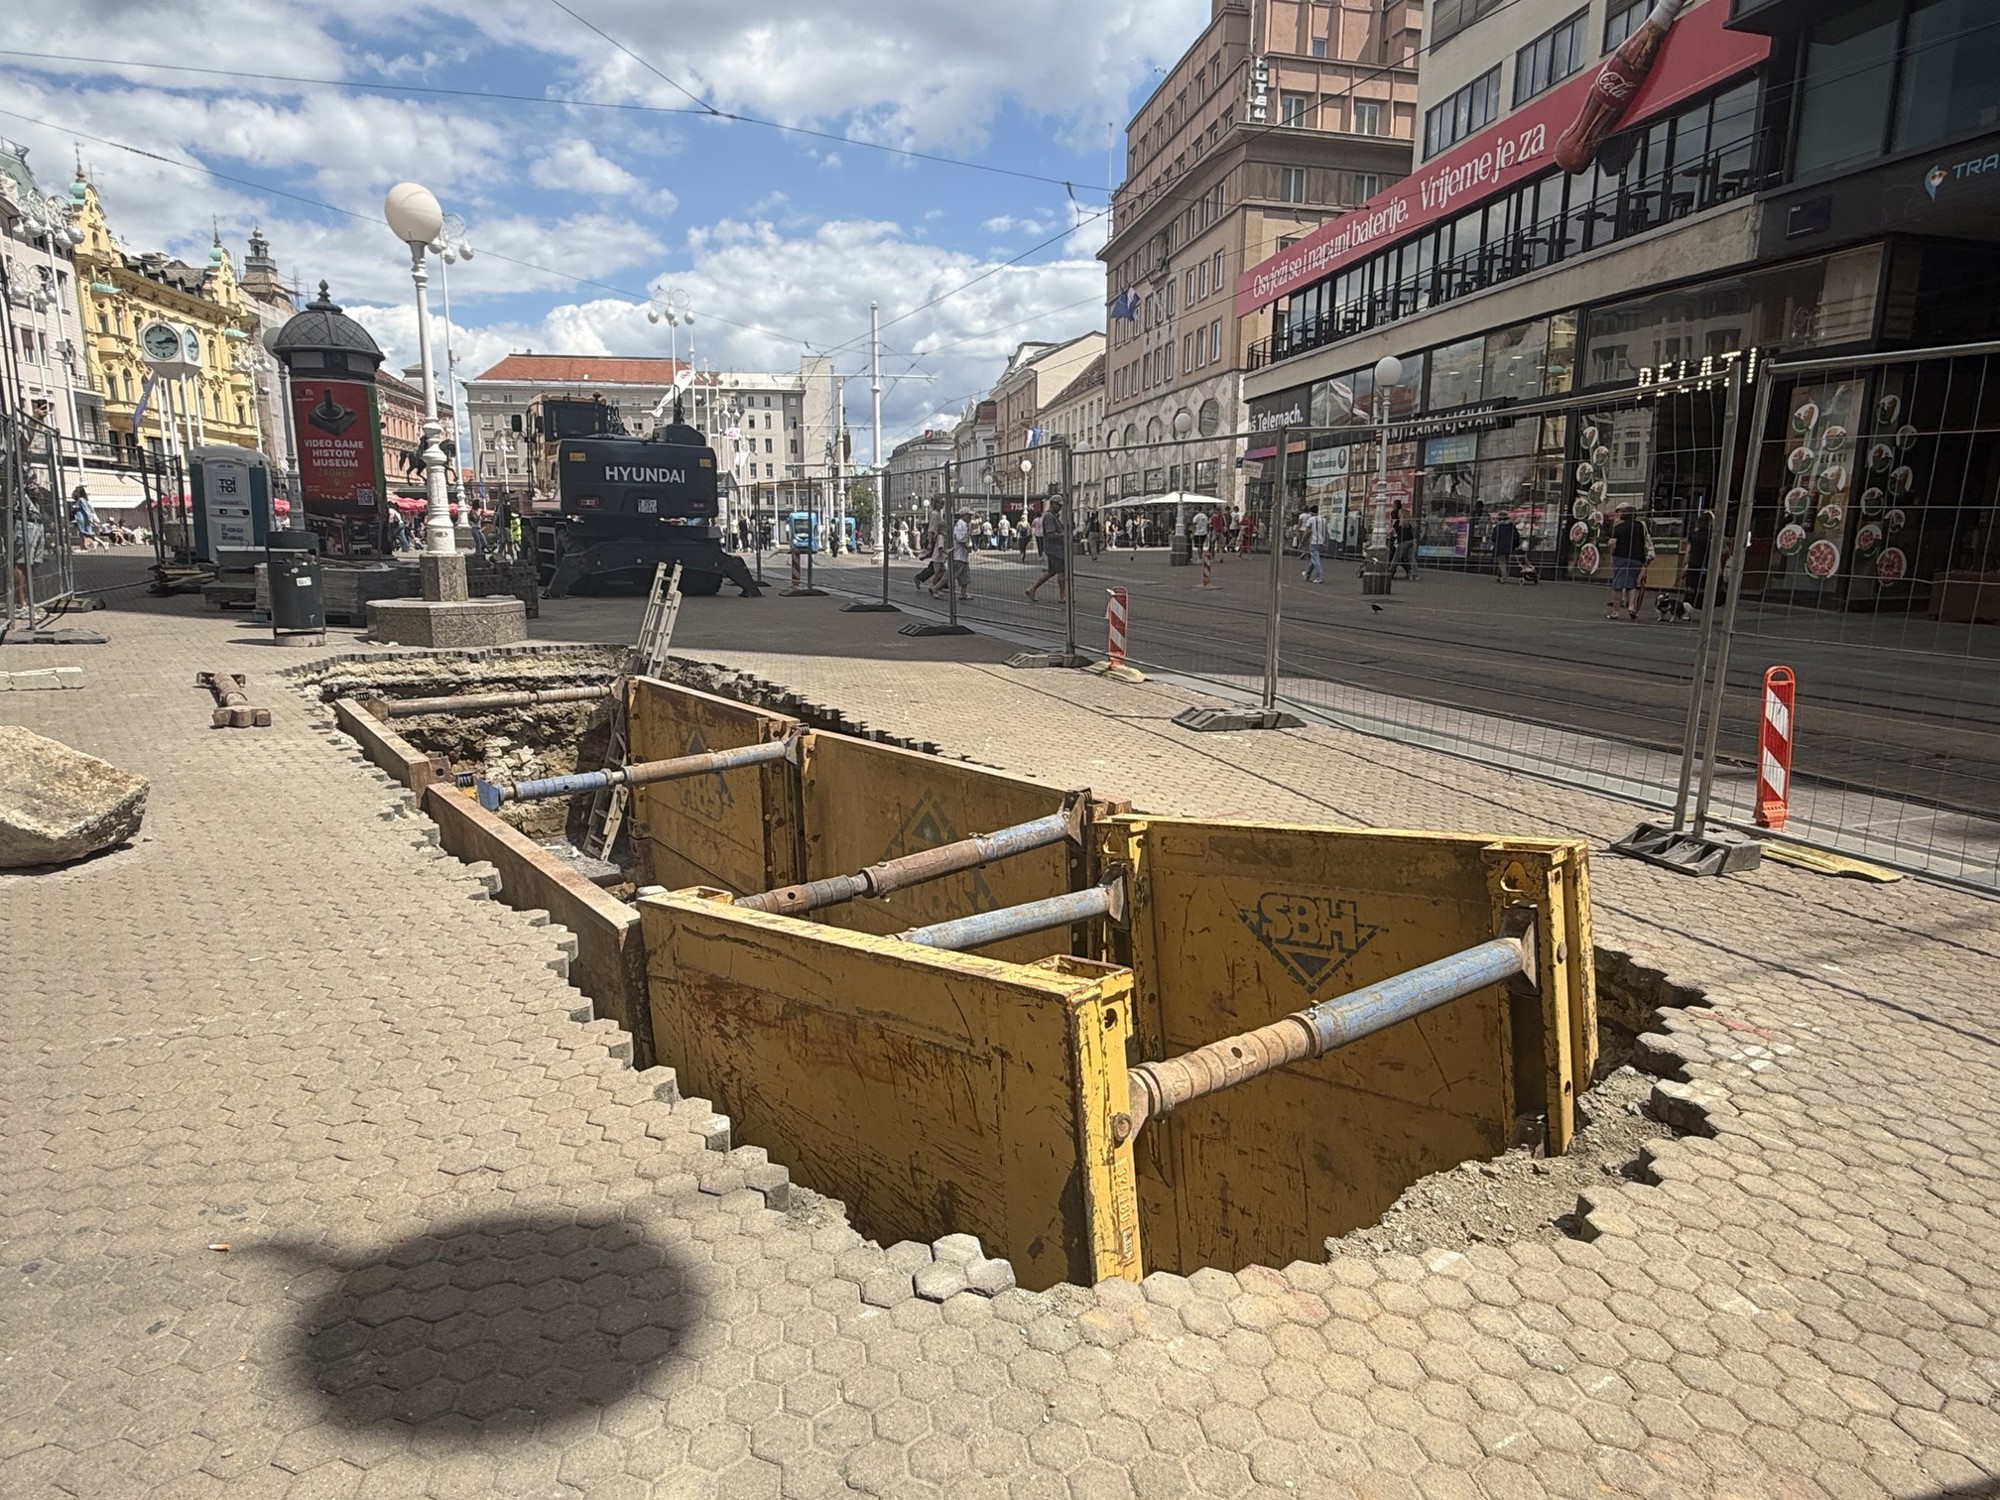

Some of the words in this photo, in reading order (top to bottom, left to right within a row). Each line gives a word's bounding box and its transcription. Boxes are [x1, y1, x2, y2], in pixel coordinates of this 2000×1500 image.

[1253, 57, 1268, 118] HOTEL
[1253, 259, 1289, 297] Osvježi
[1288, 256, 1301, 281] se
[1302, 249, 1308, 274] i
[1308, 227, 1350, 270] napuni
[1352, 196, 1409, 247] baterije.
[1421, 152, 1492, 210] Vrijeme
[1492, 137, 1515, 183] je
[1517, 123, 1546, 163] za
[1258, 403, 1304, 431] Telemach.
[304, 439, 332, 448] VIDEO
[335, 440, 364, 449] GAME
[312, 449, 356, 458] HISTORY
[313, 459, 358, 467] MUSEUM
[318, 468, 354, 477] ZAGREB
[605, 466, 685, 483] HYUNDAI
[1010, 502, 1035, 511] TISK
[1257, 891, 1358, 953] SBH
